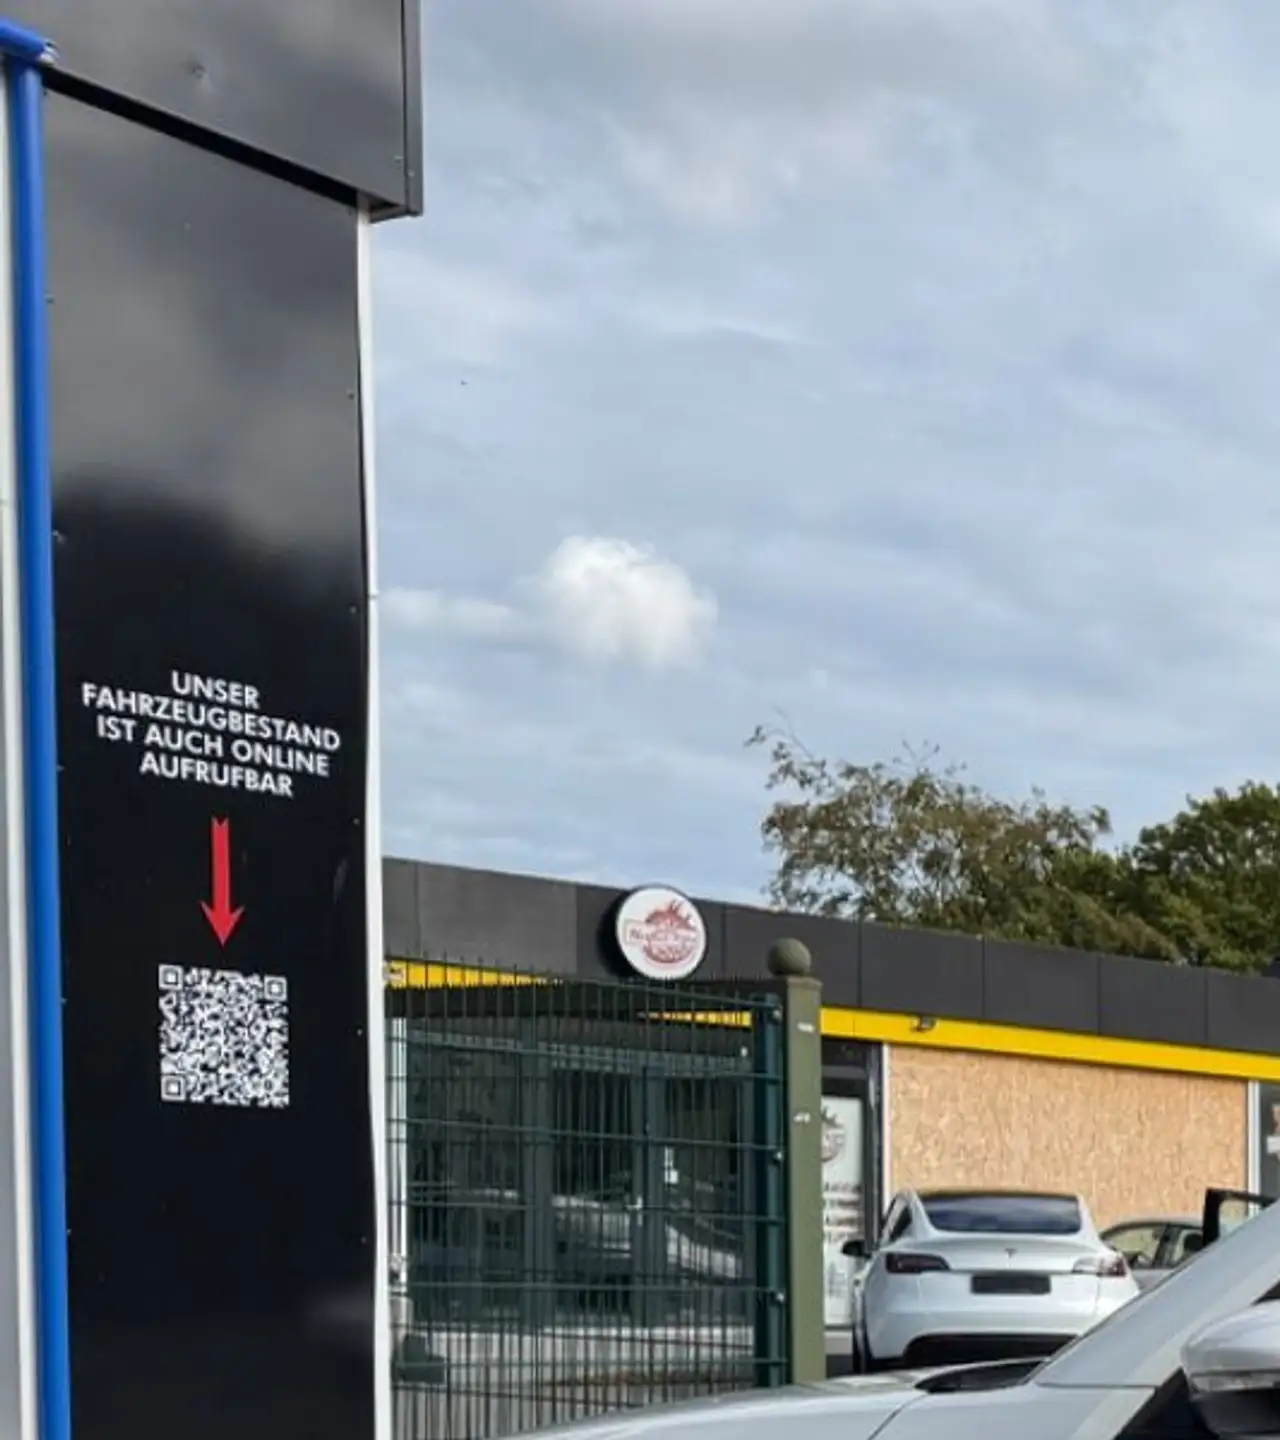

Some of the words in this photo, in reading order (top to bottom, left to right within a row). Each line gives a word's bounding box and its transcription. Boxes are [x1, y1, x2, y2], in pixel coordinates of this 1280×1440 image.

[172, 669, 260, 709] UNSER
[81, 682, 341, 751] FAHRZEUGBESTAND
[97, 715, 136, 742] IST
[144, 724, 223, 757] AUCH
[231, 739, 331, 777] ONLINE
[139, 751, 294, 797] AUFRUFBAR
